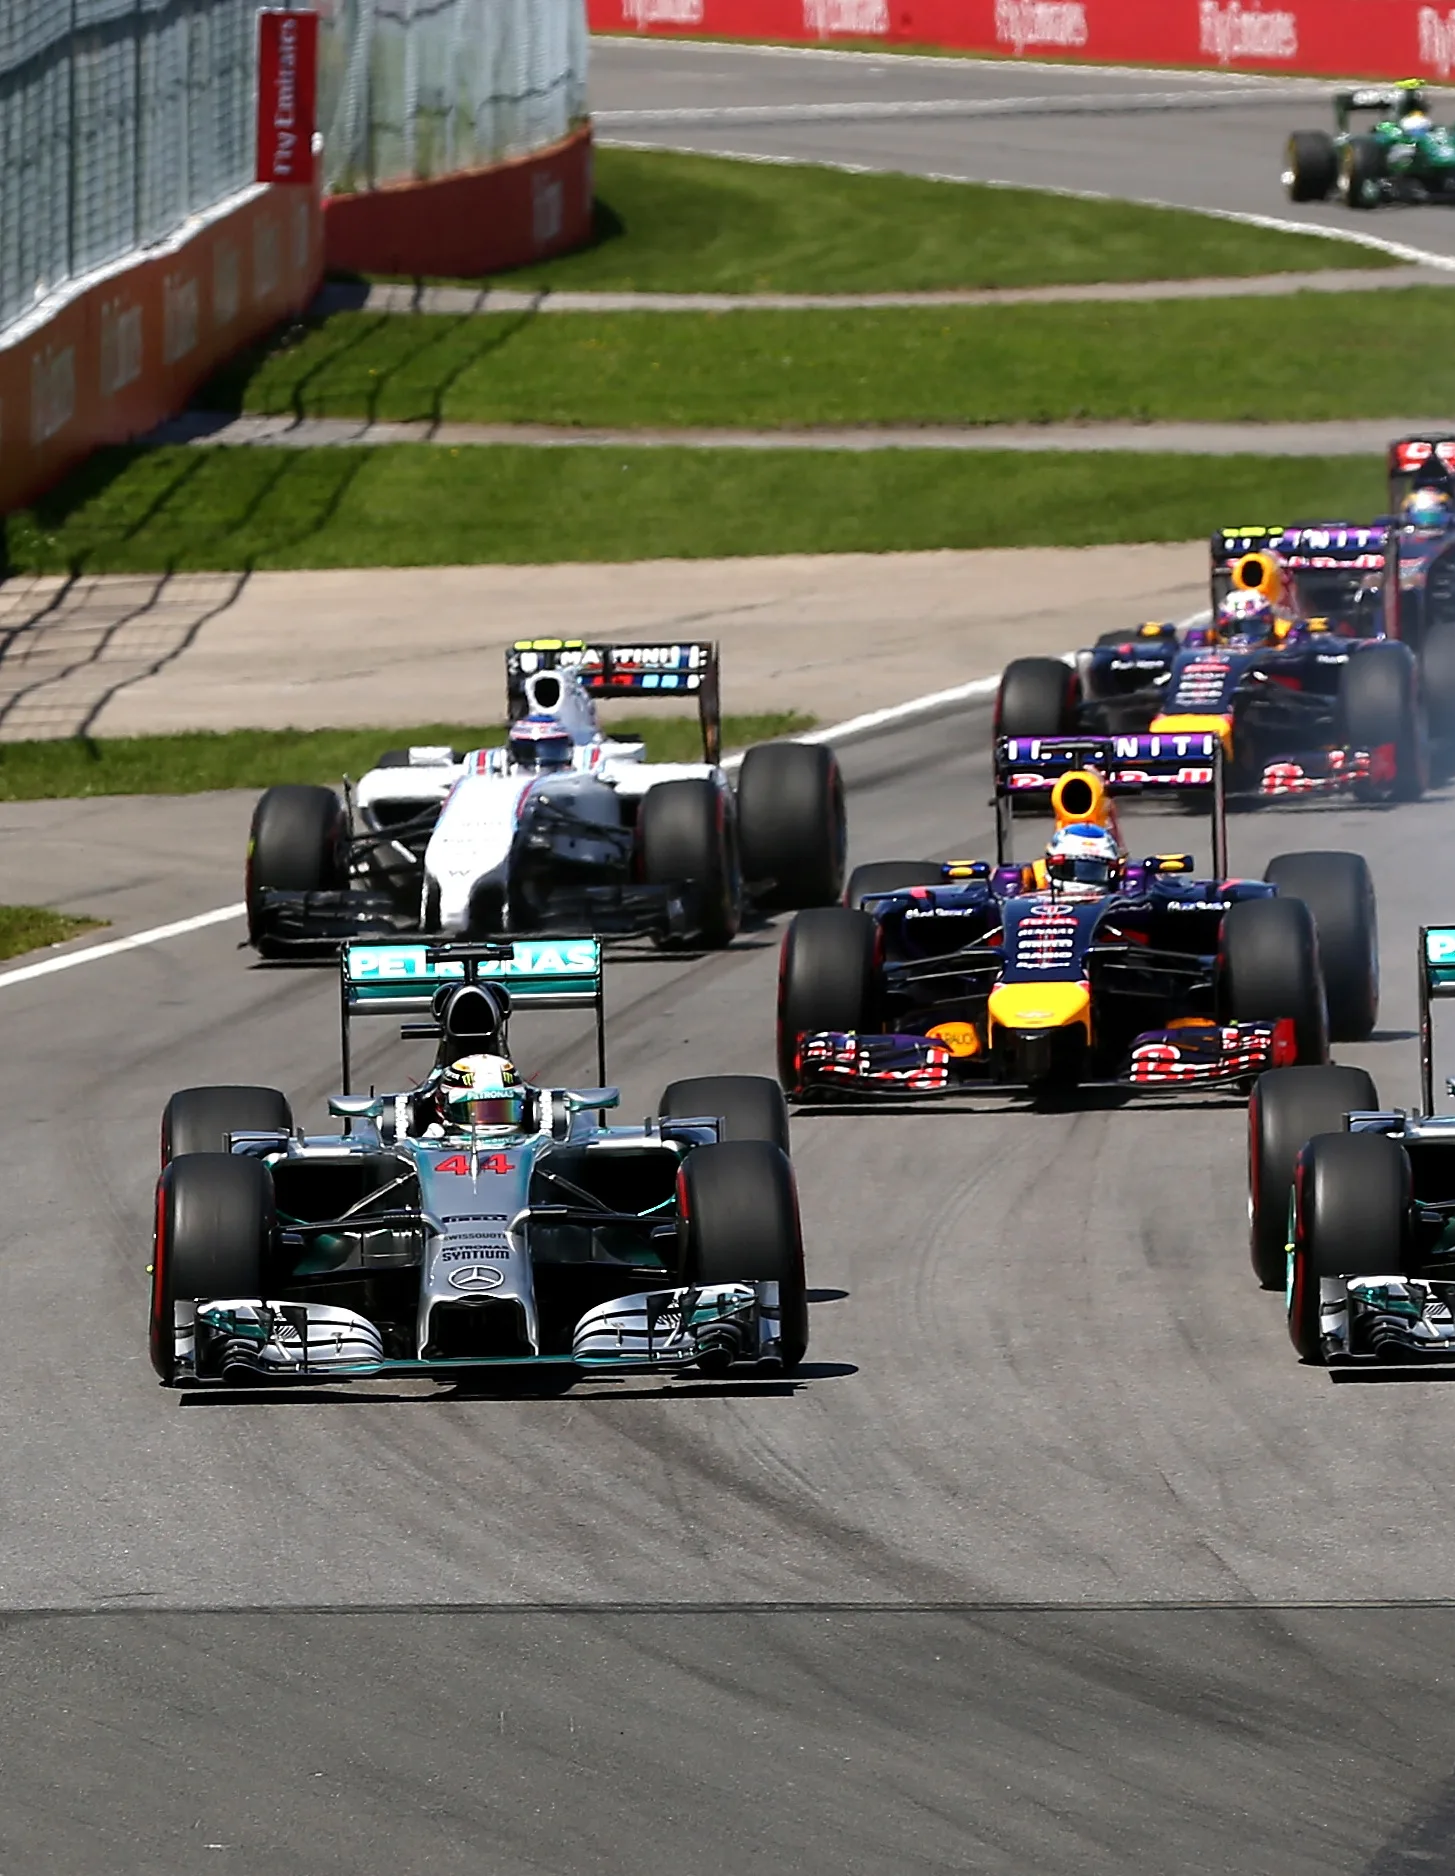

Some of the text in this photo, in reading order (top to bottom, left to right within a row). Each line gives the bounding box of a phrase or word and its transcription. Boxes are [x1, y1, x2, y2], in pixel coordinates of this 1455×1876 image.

[560, 647, 669, 666] MATINI
[1007, 734, 1214, 761] INNITI
[467, 1089, 515, 1101] PETRONAS
[435, 1153, 515, 1175] 44
[442, 1251, 510, 1262] SYNTIUM
